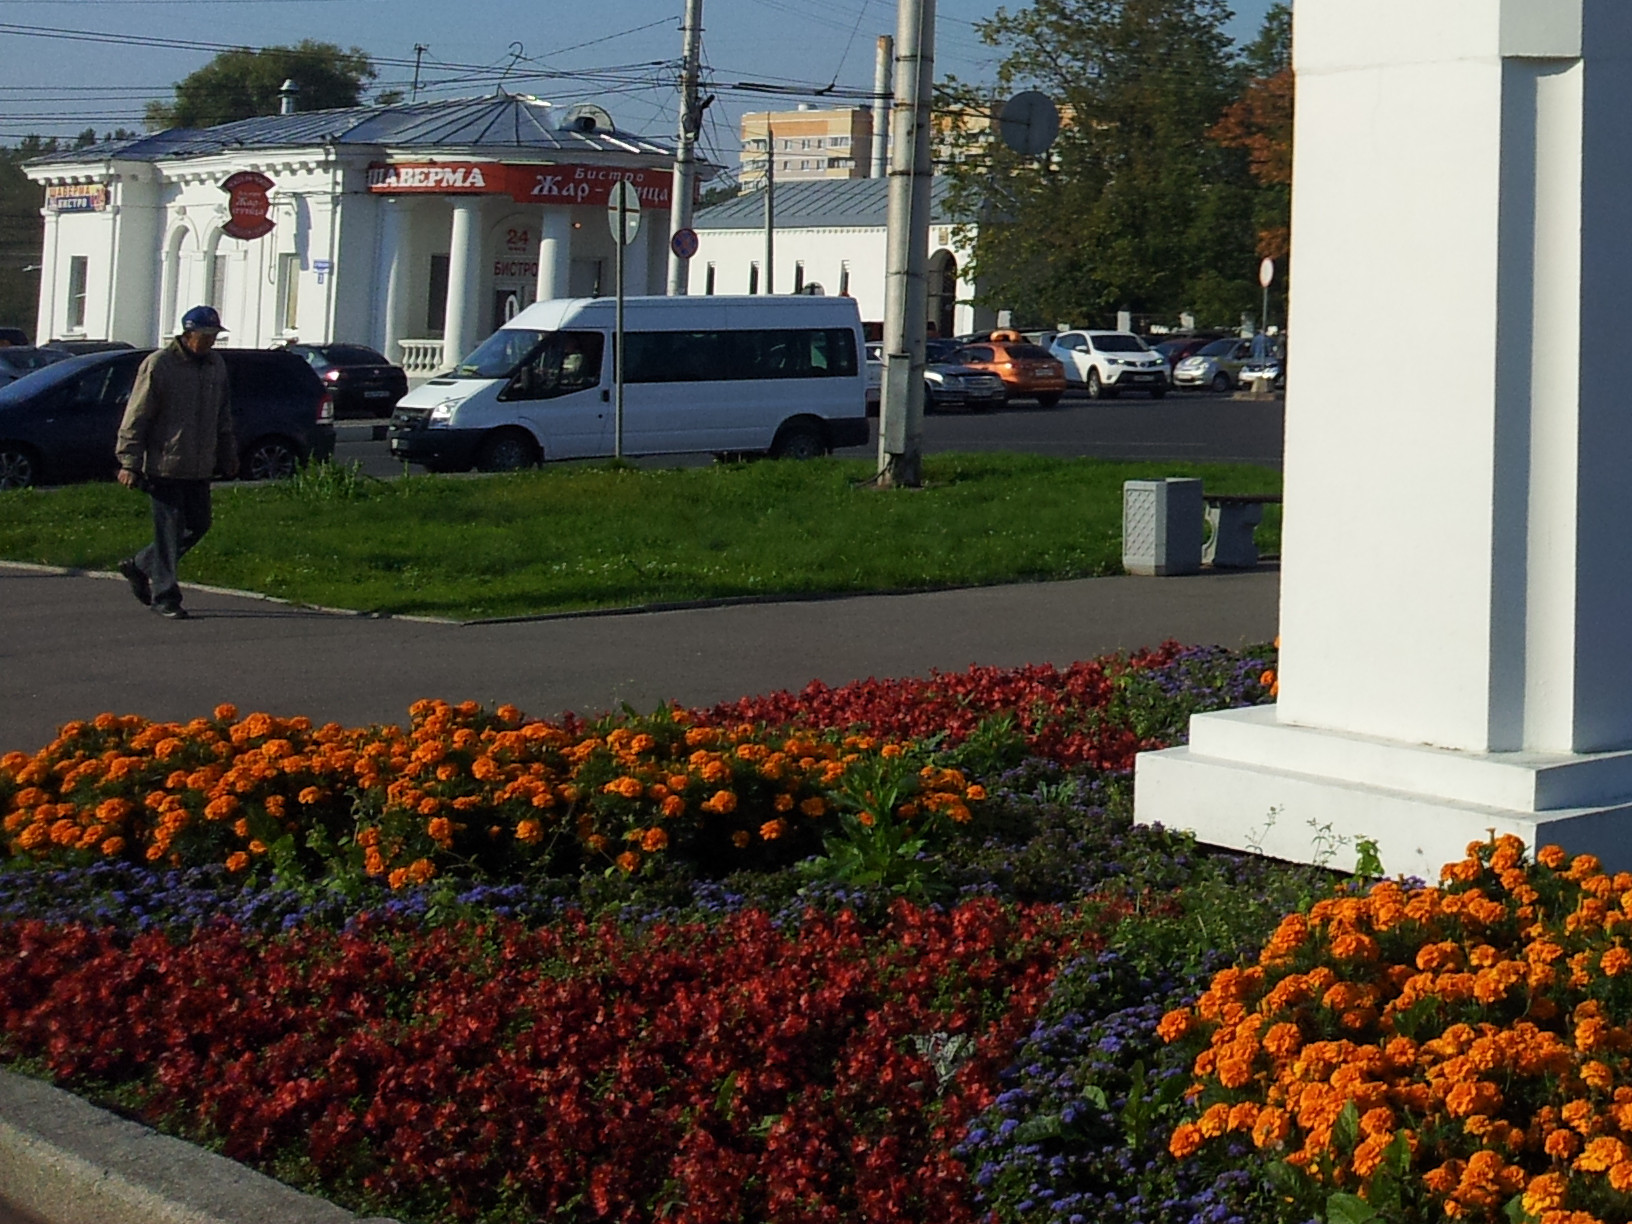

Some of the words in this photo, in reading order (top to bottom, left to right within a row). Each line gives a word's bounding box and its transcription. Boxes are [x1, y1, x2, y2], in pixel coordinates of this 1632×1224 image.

[368, 167, 486, 187] ШАВЕРМА
[574, 167, 645, 182] Бистро
[506, 228, 530, 245] 24
[493, 261, 538, 277] БИСТРО
